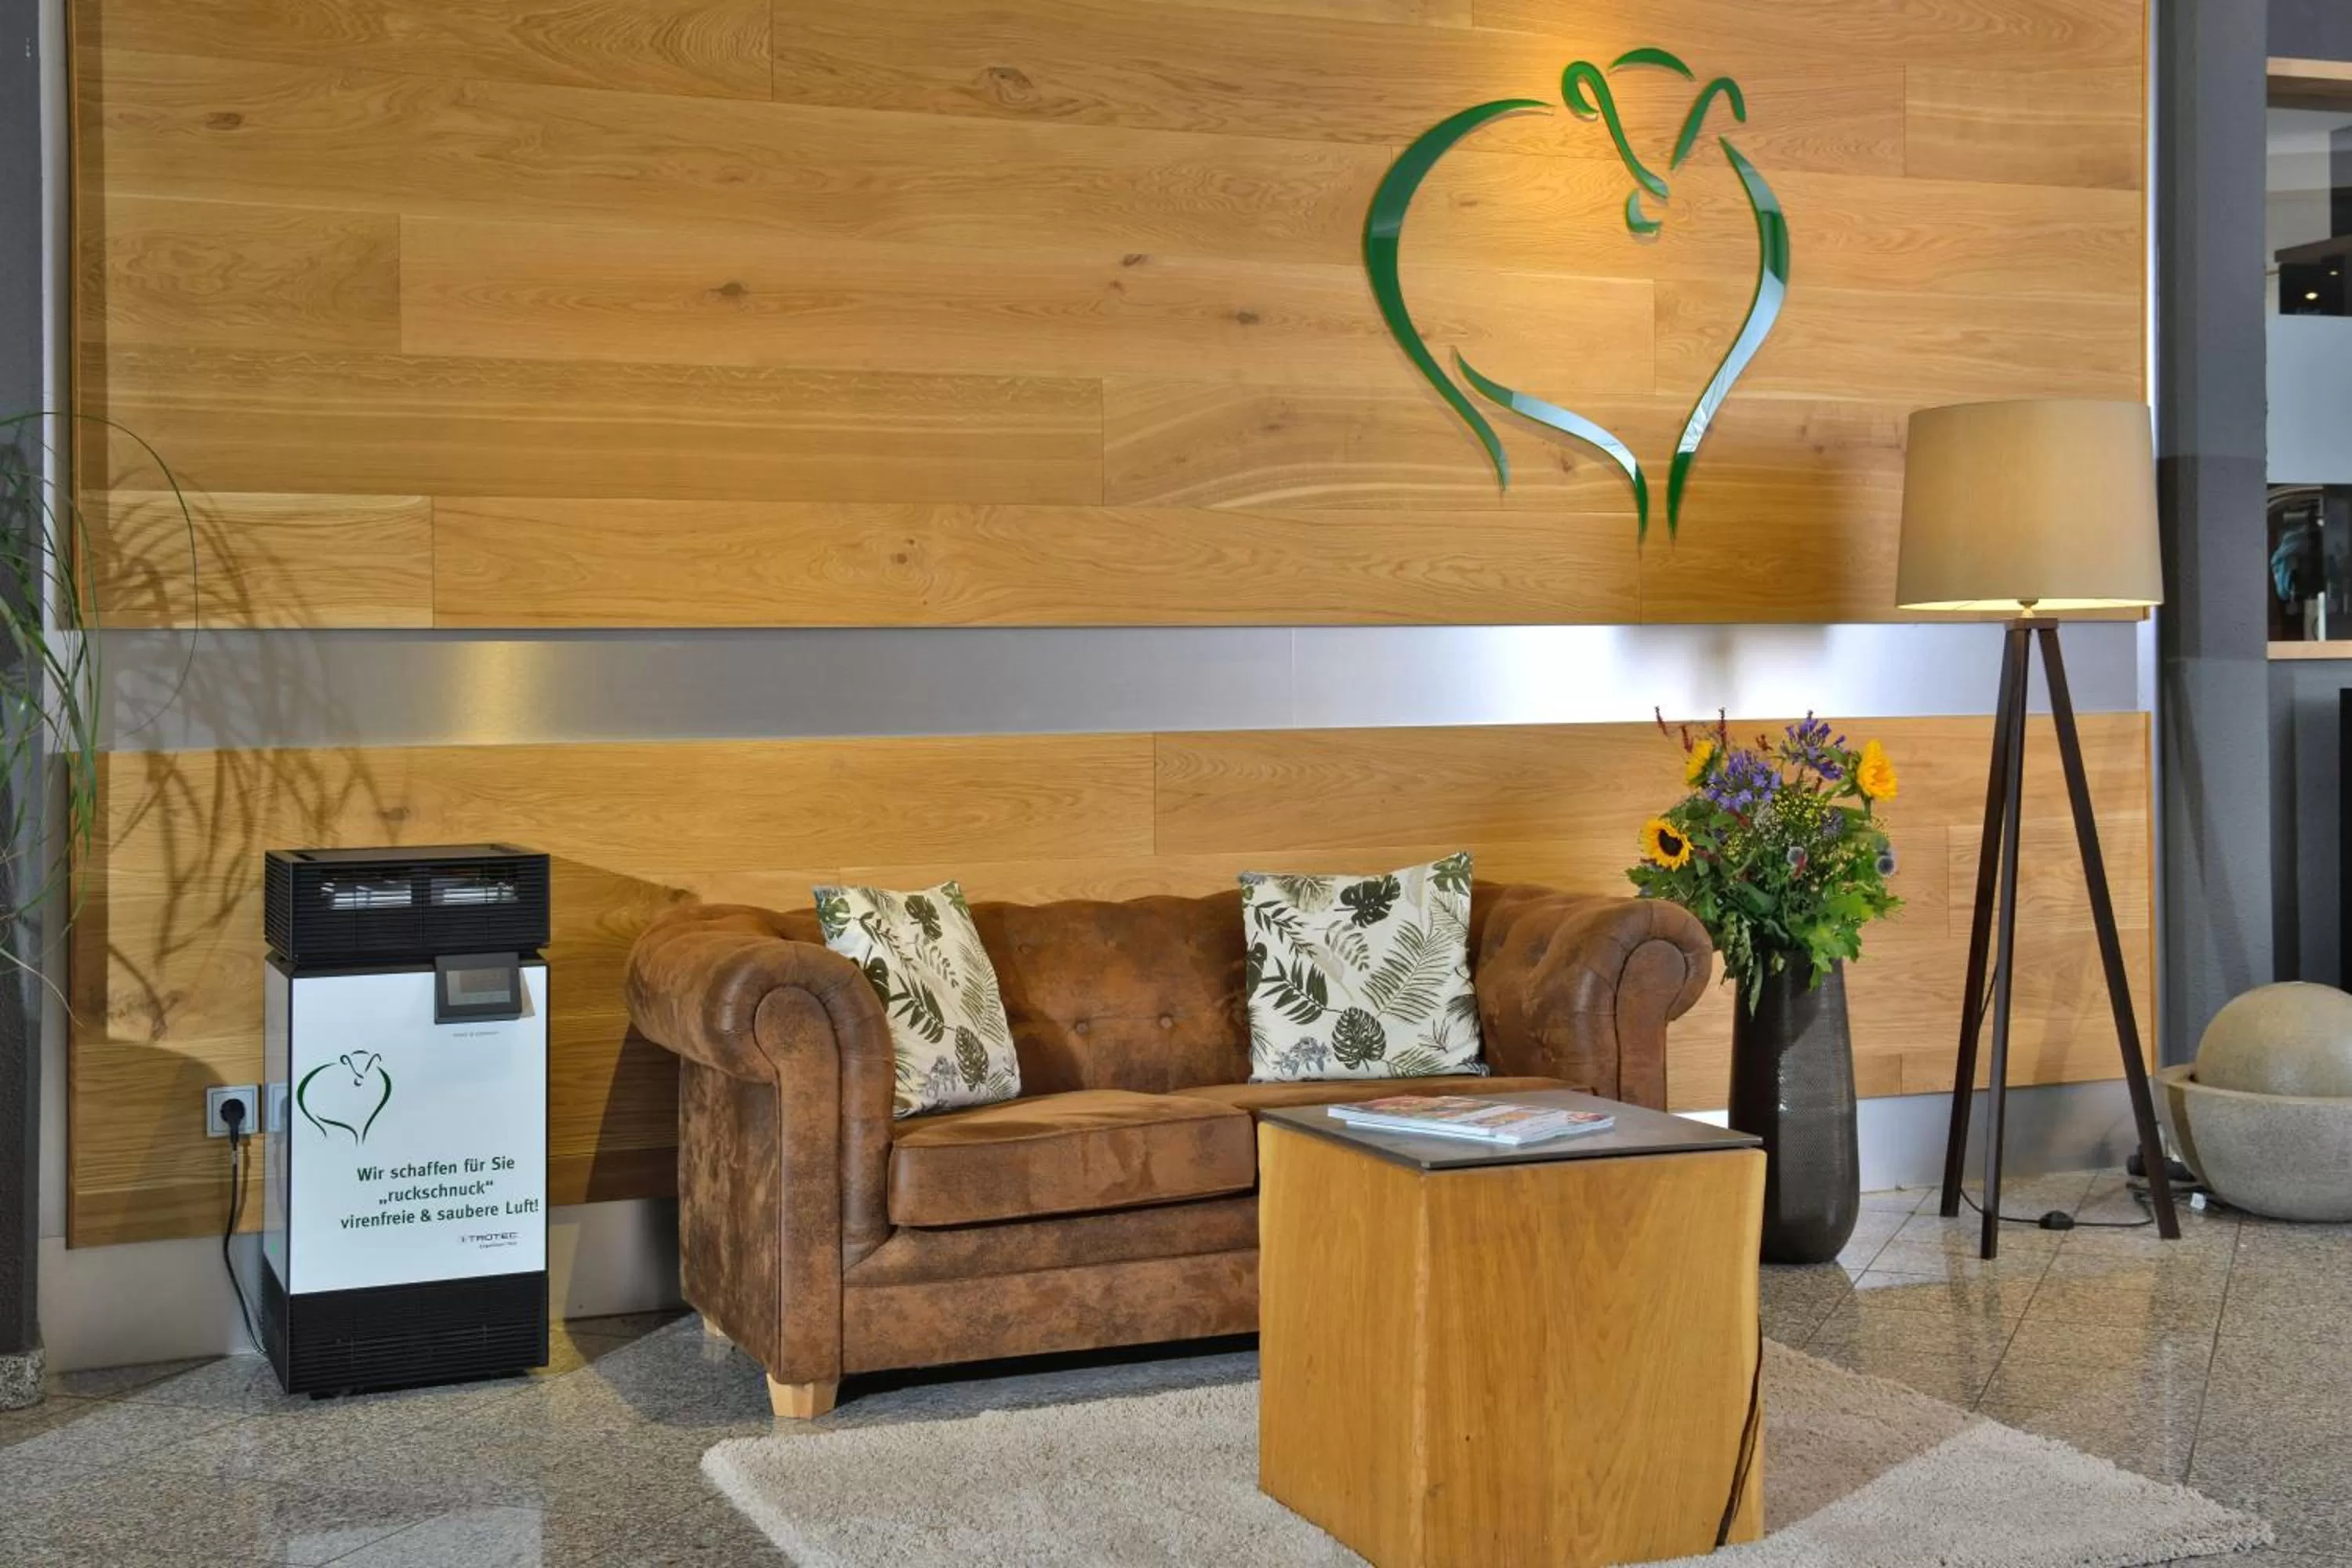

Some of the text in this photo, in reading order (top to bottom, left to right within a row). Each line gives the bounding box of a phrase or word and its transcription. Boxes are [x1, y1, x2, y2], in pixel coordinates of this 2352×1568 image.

[357, 1156, 515, 1181] Wir schaffen für Sie
[340, 1199, 539, 1229] virenfreie & saubere Luft!
